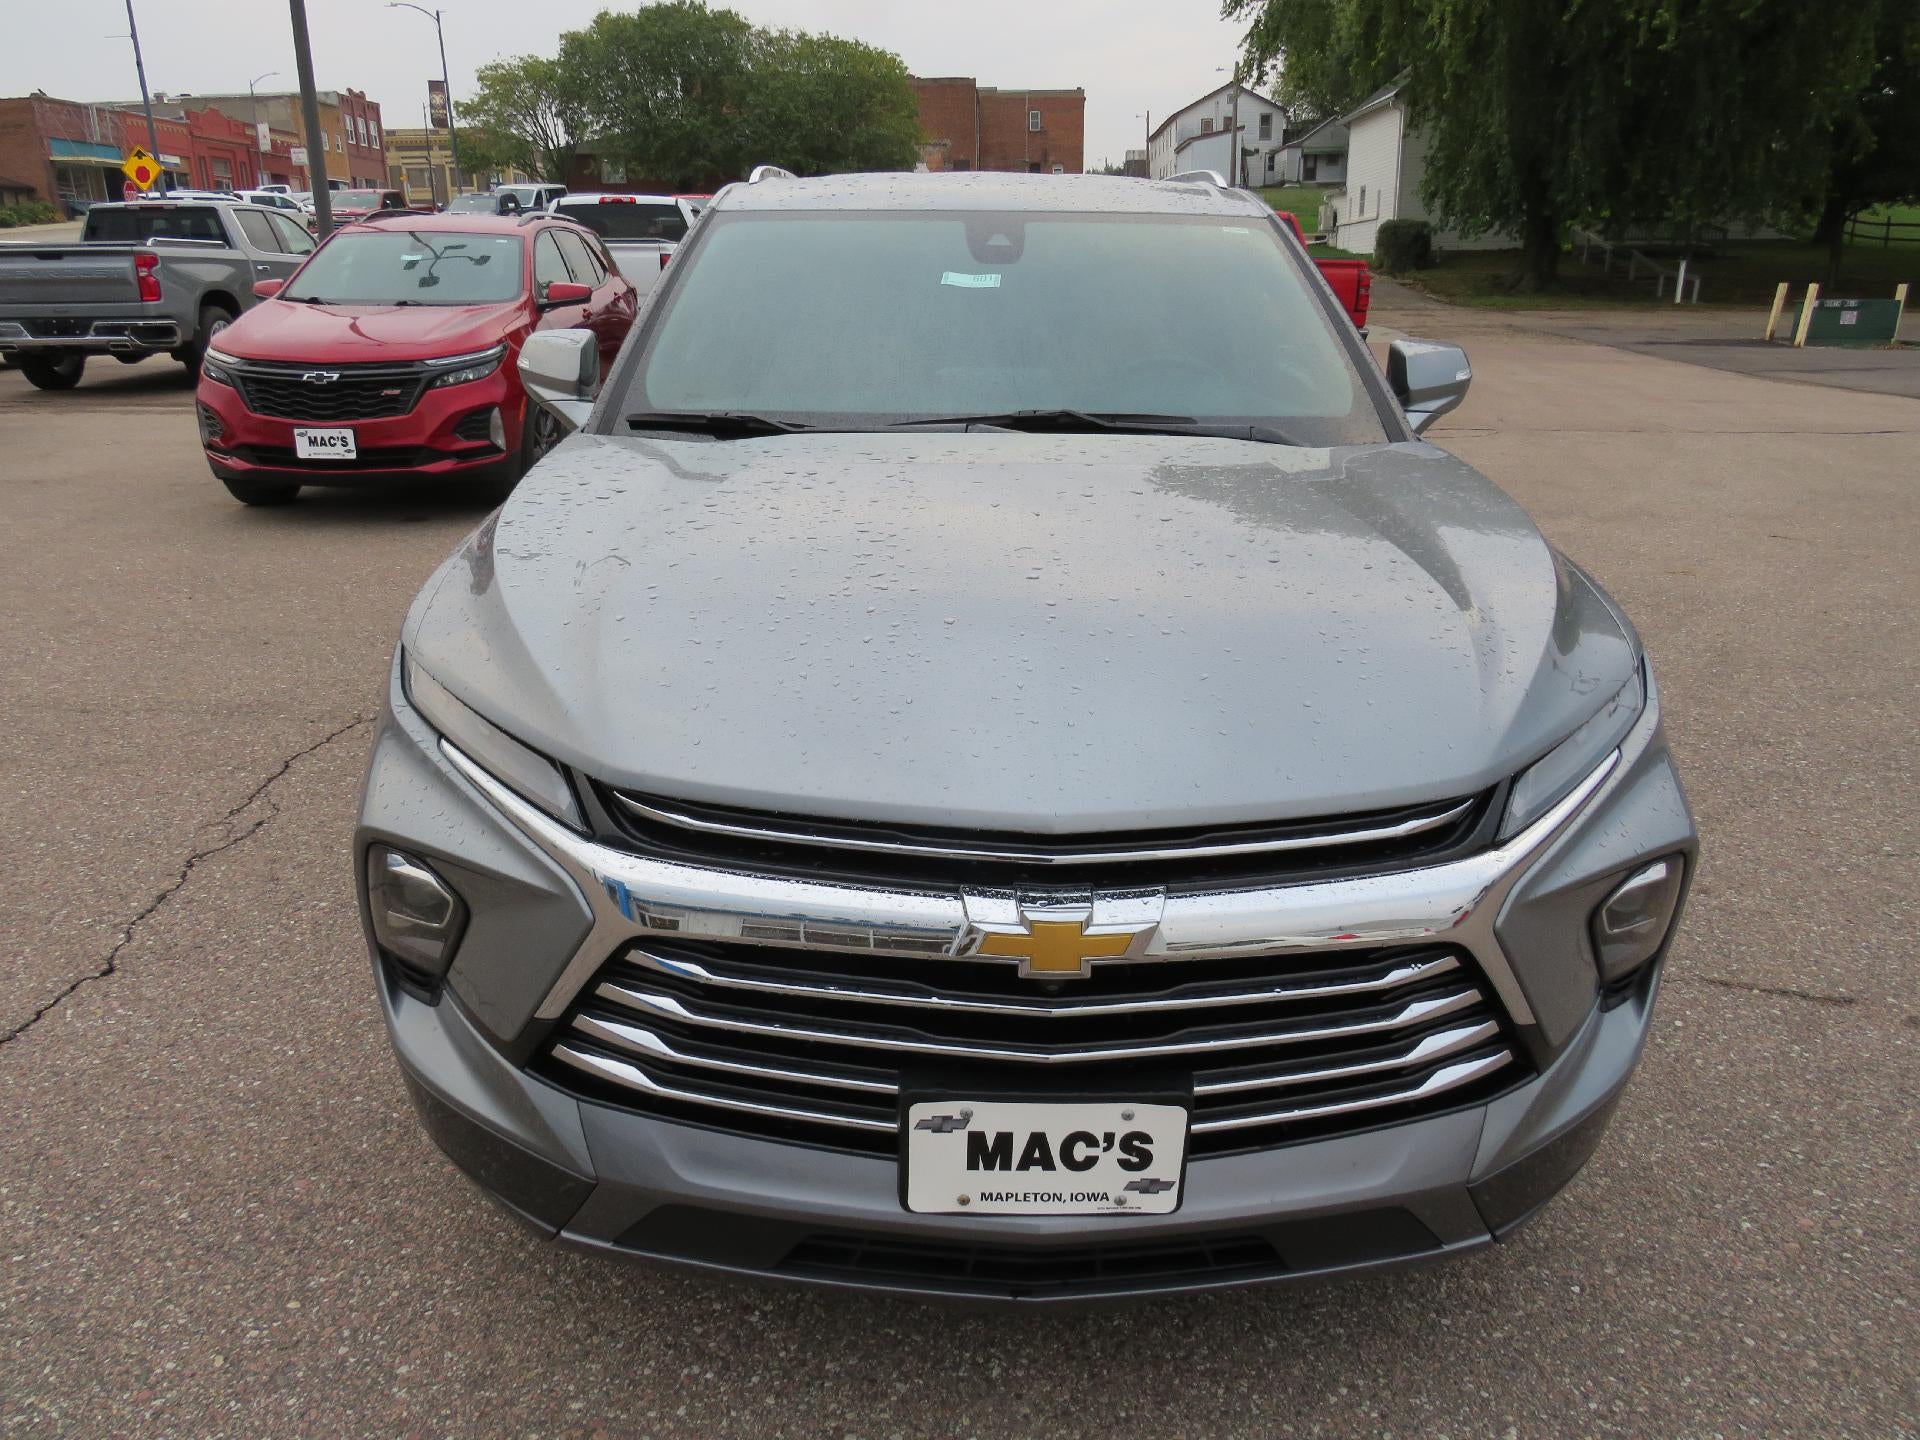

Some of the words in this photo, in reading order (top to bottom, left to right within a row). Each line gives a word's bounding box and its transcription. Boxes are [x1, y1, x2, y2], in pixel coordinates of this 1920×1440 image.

[125, 190, 137, 200] STOP
[308, 436, 349, 447] MAC'S
[967, 1131, 1154, 1172] MAC'S
[980, 1192, 1067, 1203] MAPLETON,
[1070, 1192, 1110, 1202] IOWA
